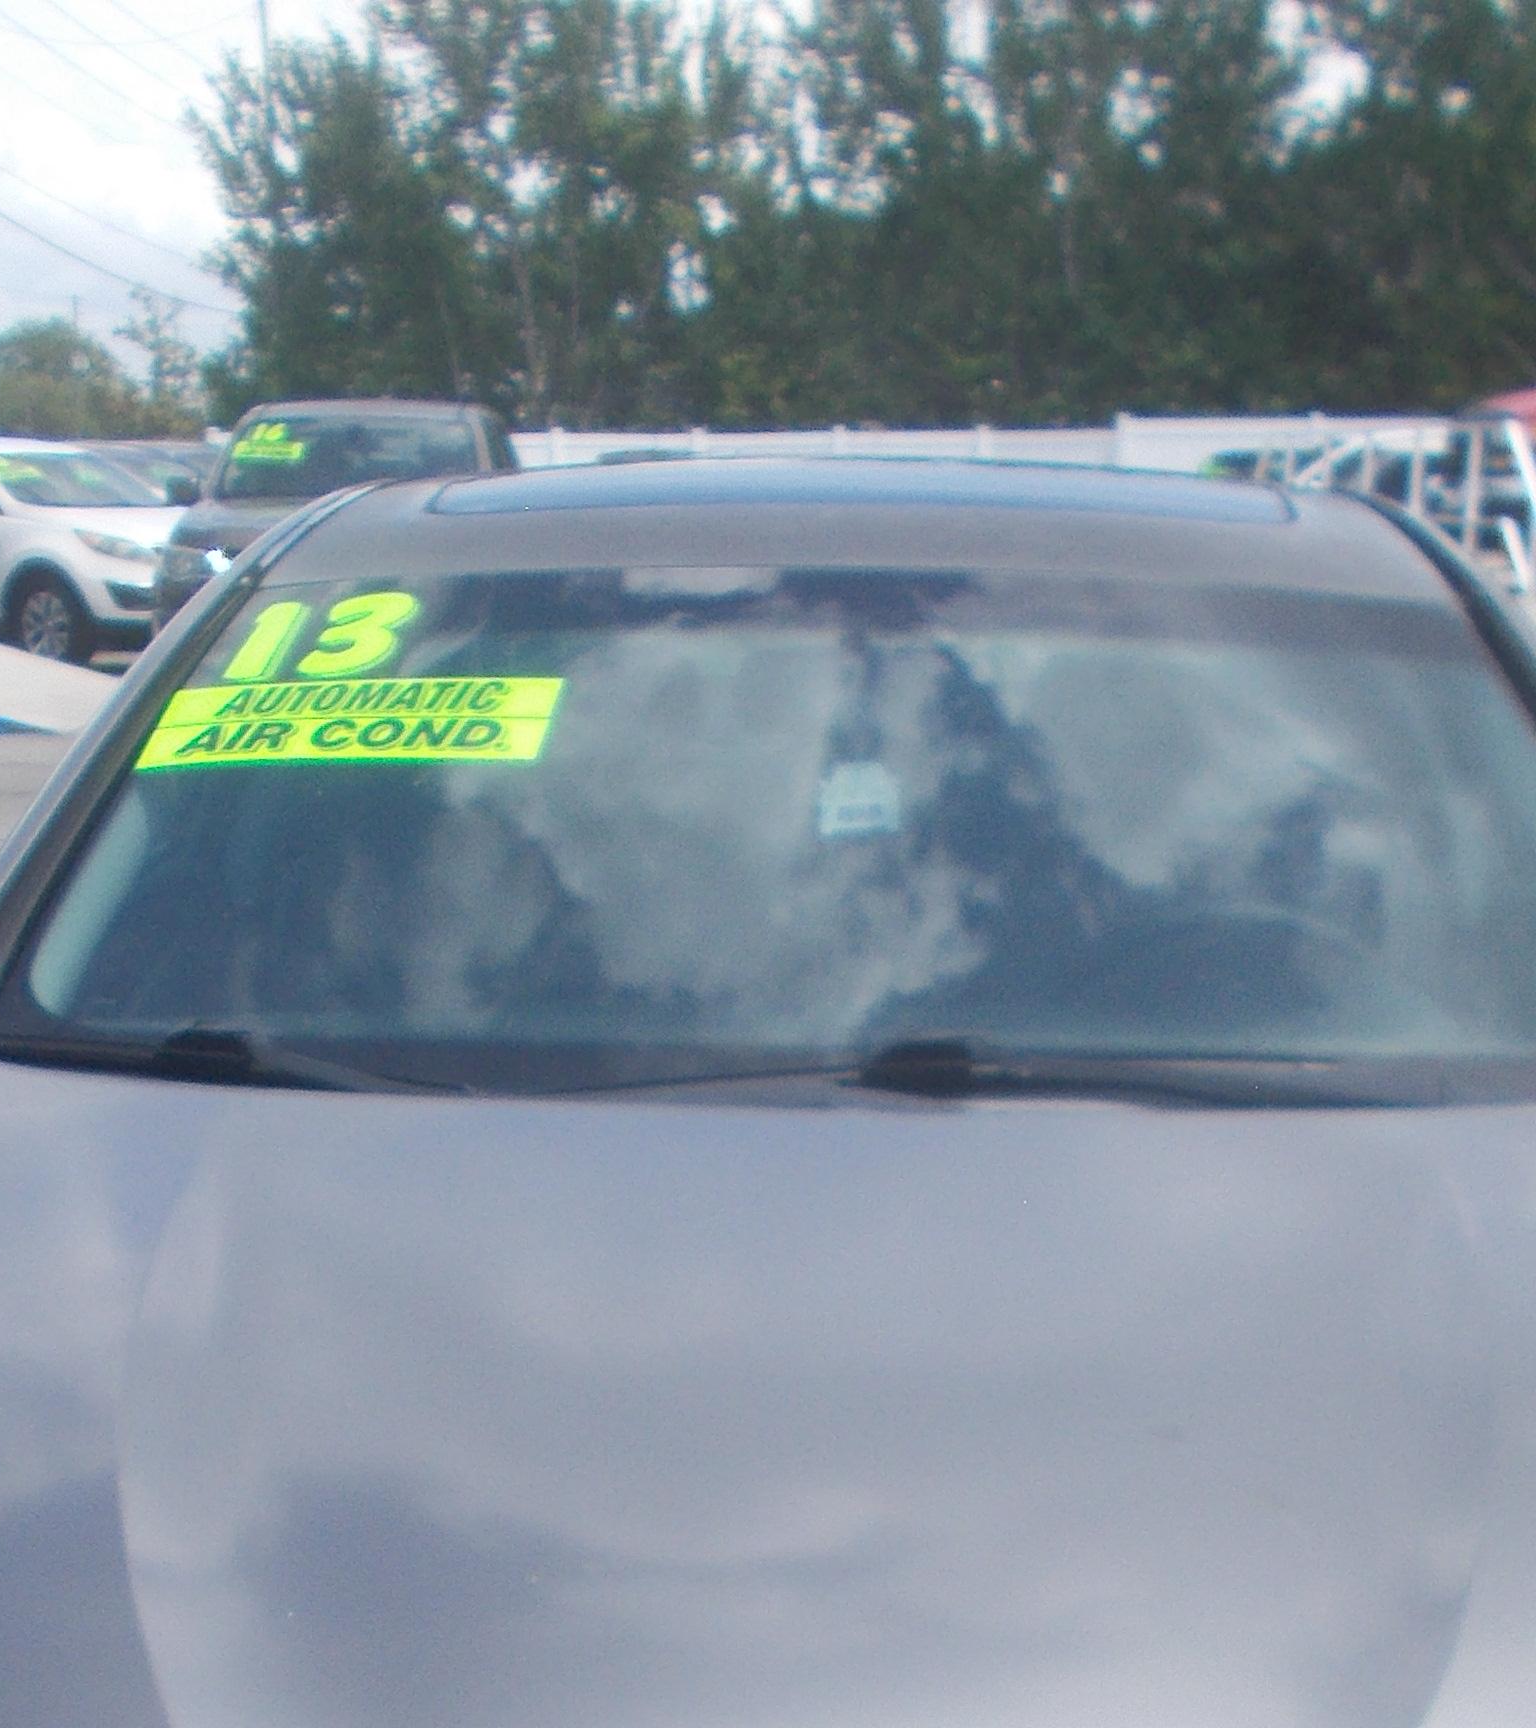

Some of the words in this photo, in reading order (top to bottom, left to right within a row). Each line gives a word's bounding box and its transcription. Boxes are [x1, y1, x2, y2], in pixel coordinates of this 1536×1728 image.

[223, 591, 421, 680] 13
[214, 681, 507, 717] AUTOMATIC
[175, 719, 296, 757] AIR
[310, 716, 510, 750] COND.
